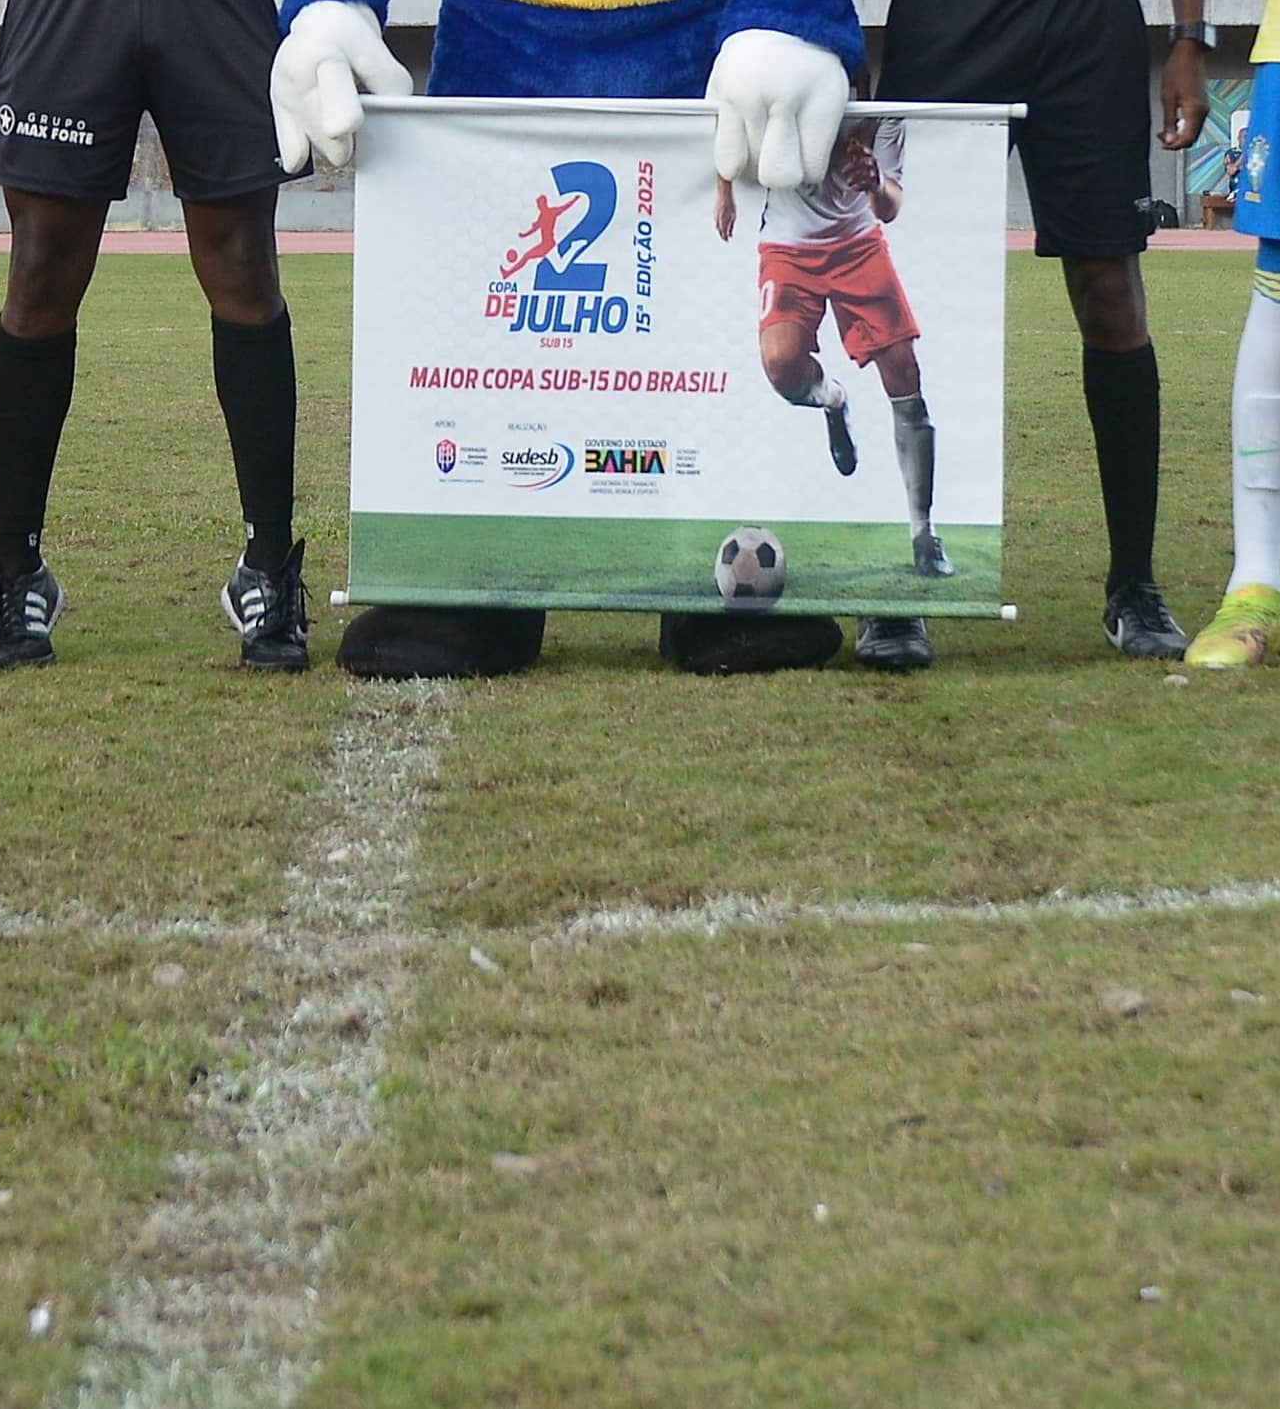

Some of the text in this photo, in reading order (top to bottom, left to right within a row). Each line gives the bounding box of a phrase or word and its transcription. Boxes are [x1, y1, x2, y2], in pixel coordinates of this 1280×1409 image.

[16, 121, 94, 145] MAX FORTE
[27, 112, 86, 130] GRUPO
[638, 161, 654, 216] 2025
[533, 161, 618, 292] 2
[633, 221, 656, 297] EDIÇÃO
[488, 281, 518, 293] COPA
[484, 294, 629, 334] DE JULHO
[539, 337, 573, 348] SUB 15
[409, 366, 728, 394] MAIOR COPA SUB-15 DO BRASIL!
[585, 439, 667, 448] GOVERNO DO ESTADO
[501, 447, 559, 465] sudesb
